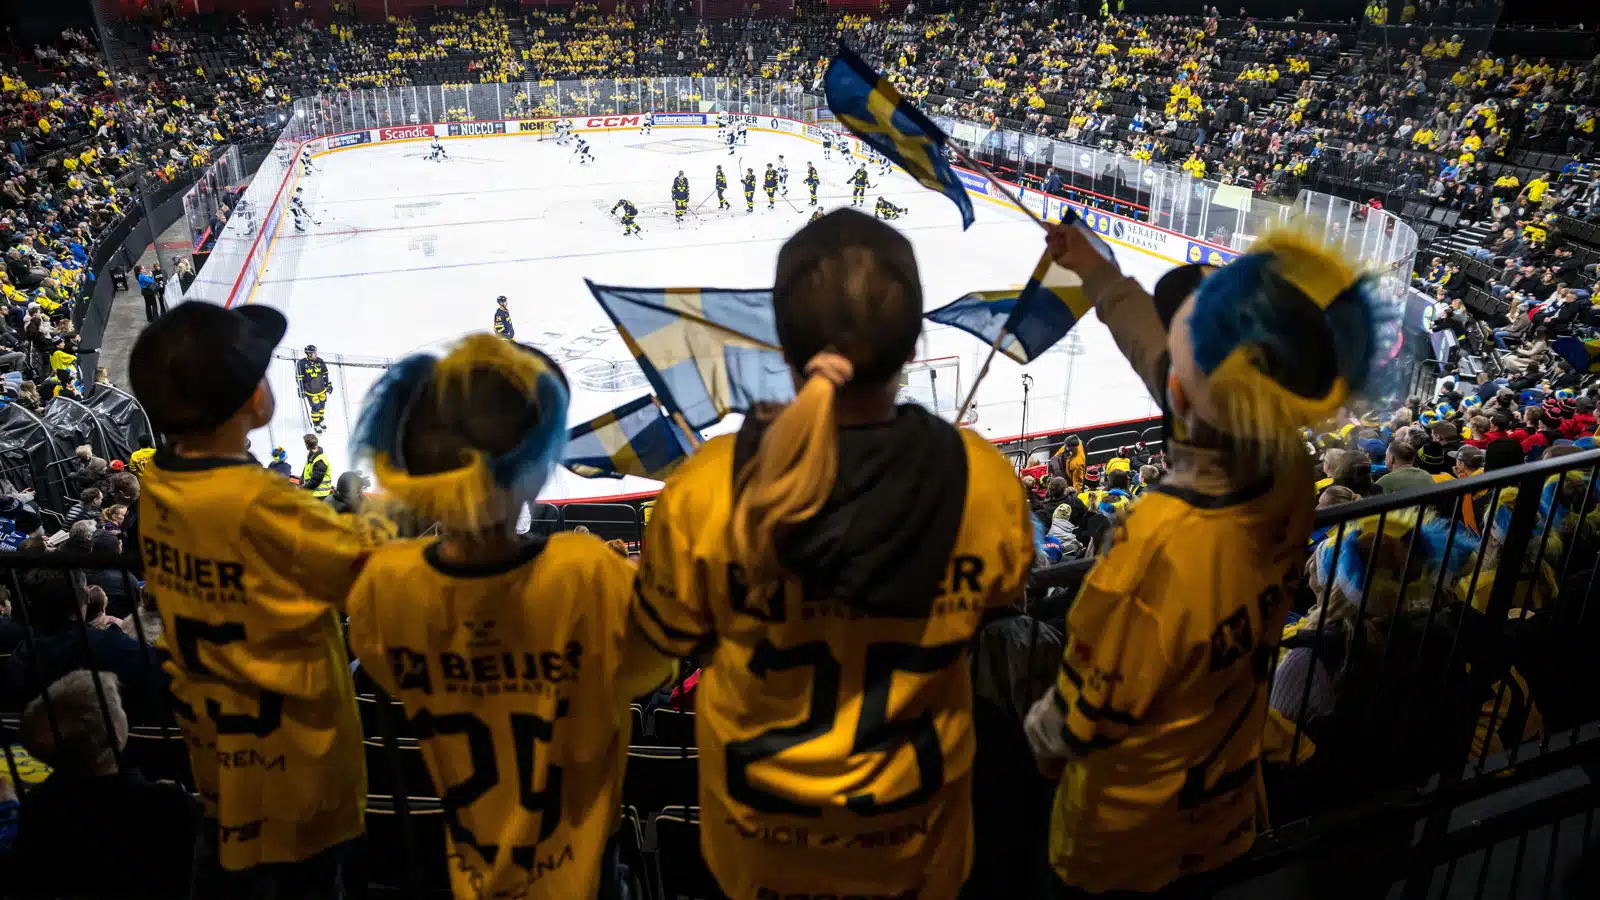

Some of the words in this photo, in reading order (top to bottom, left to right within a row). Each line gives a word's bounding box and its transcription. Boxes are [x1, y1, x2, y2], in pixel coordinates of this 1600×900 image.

[460, 122, 494, 135] NOCCO
[586, 116, 640, 128] CCM
[385, 125, 429, 140] Scandic
[1127, 223, 1167, 244] SERAFIM
[1126, 236, 1158, 251] FINANS
[726, 638, 972, 817] 25
